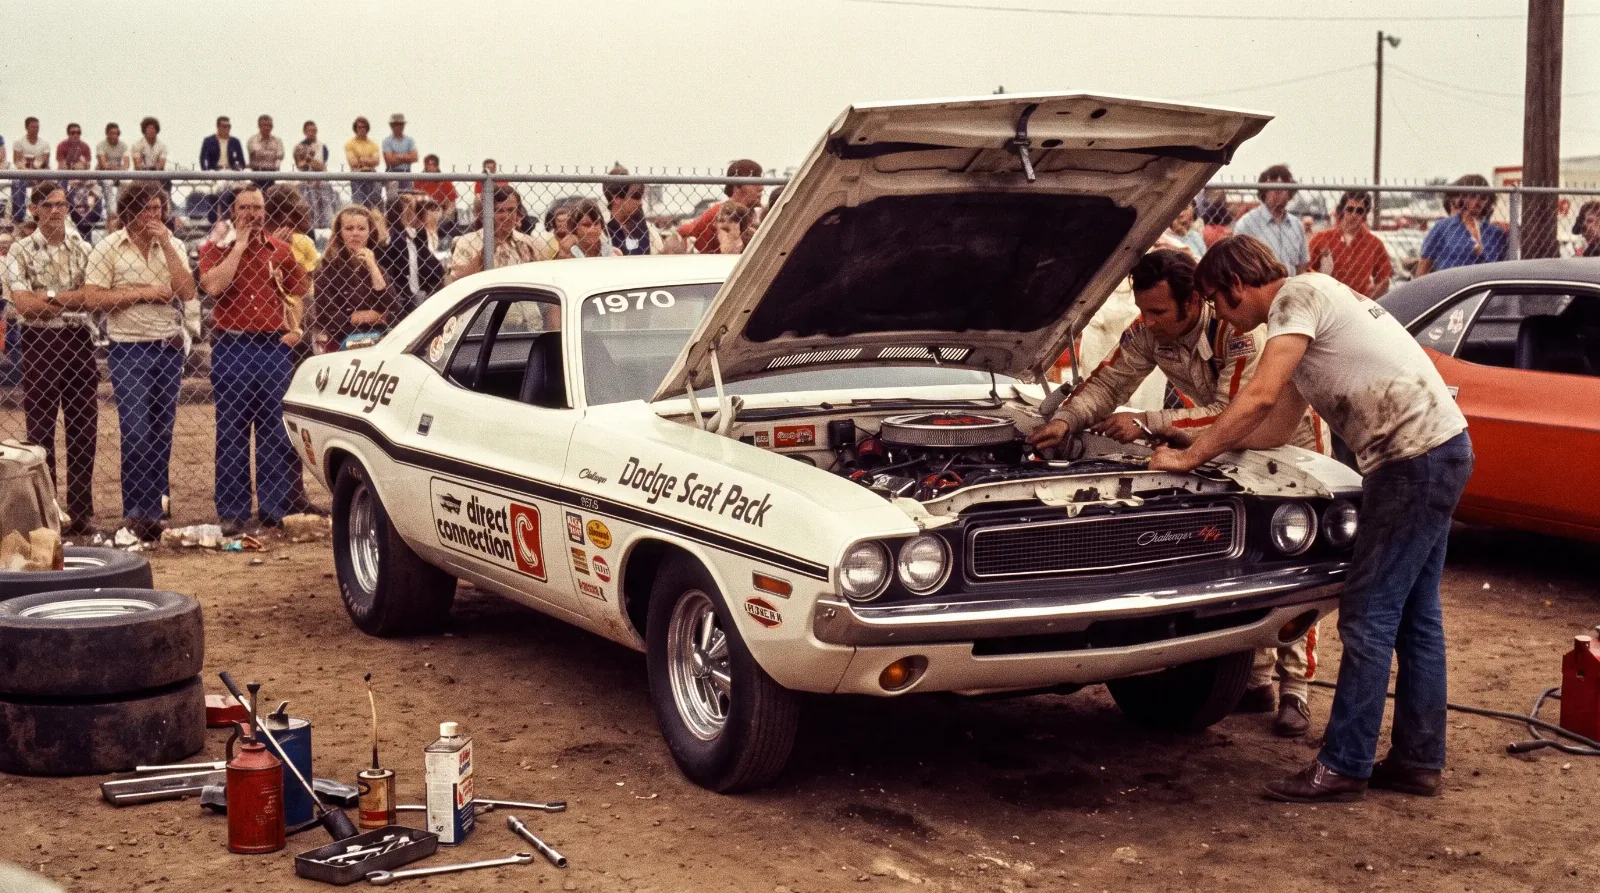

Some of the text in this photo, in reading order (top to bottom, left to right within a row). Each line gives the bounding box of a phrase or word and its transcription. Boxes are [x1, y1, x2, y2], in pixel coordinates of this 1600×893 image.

[592, 290, 676, 315] 1970
[337, 358, 400, 413] Dodge
[618, 456, 774, 528] Dodge Scat Pack
[466, 494, 510, 535] direct
[436, 518, 515, 563] connection
[1136, 530, 1193, 546] Challenger
